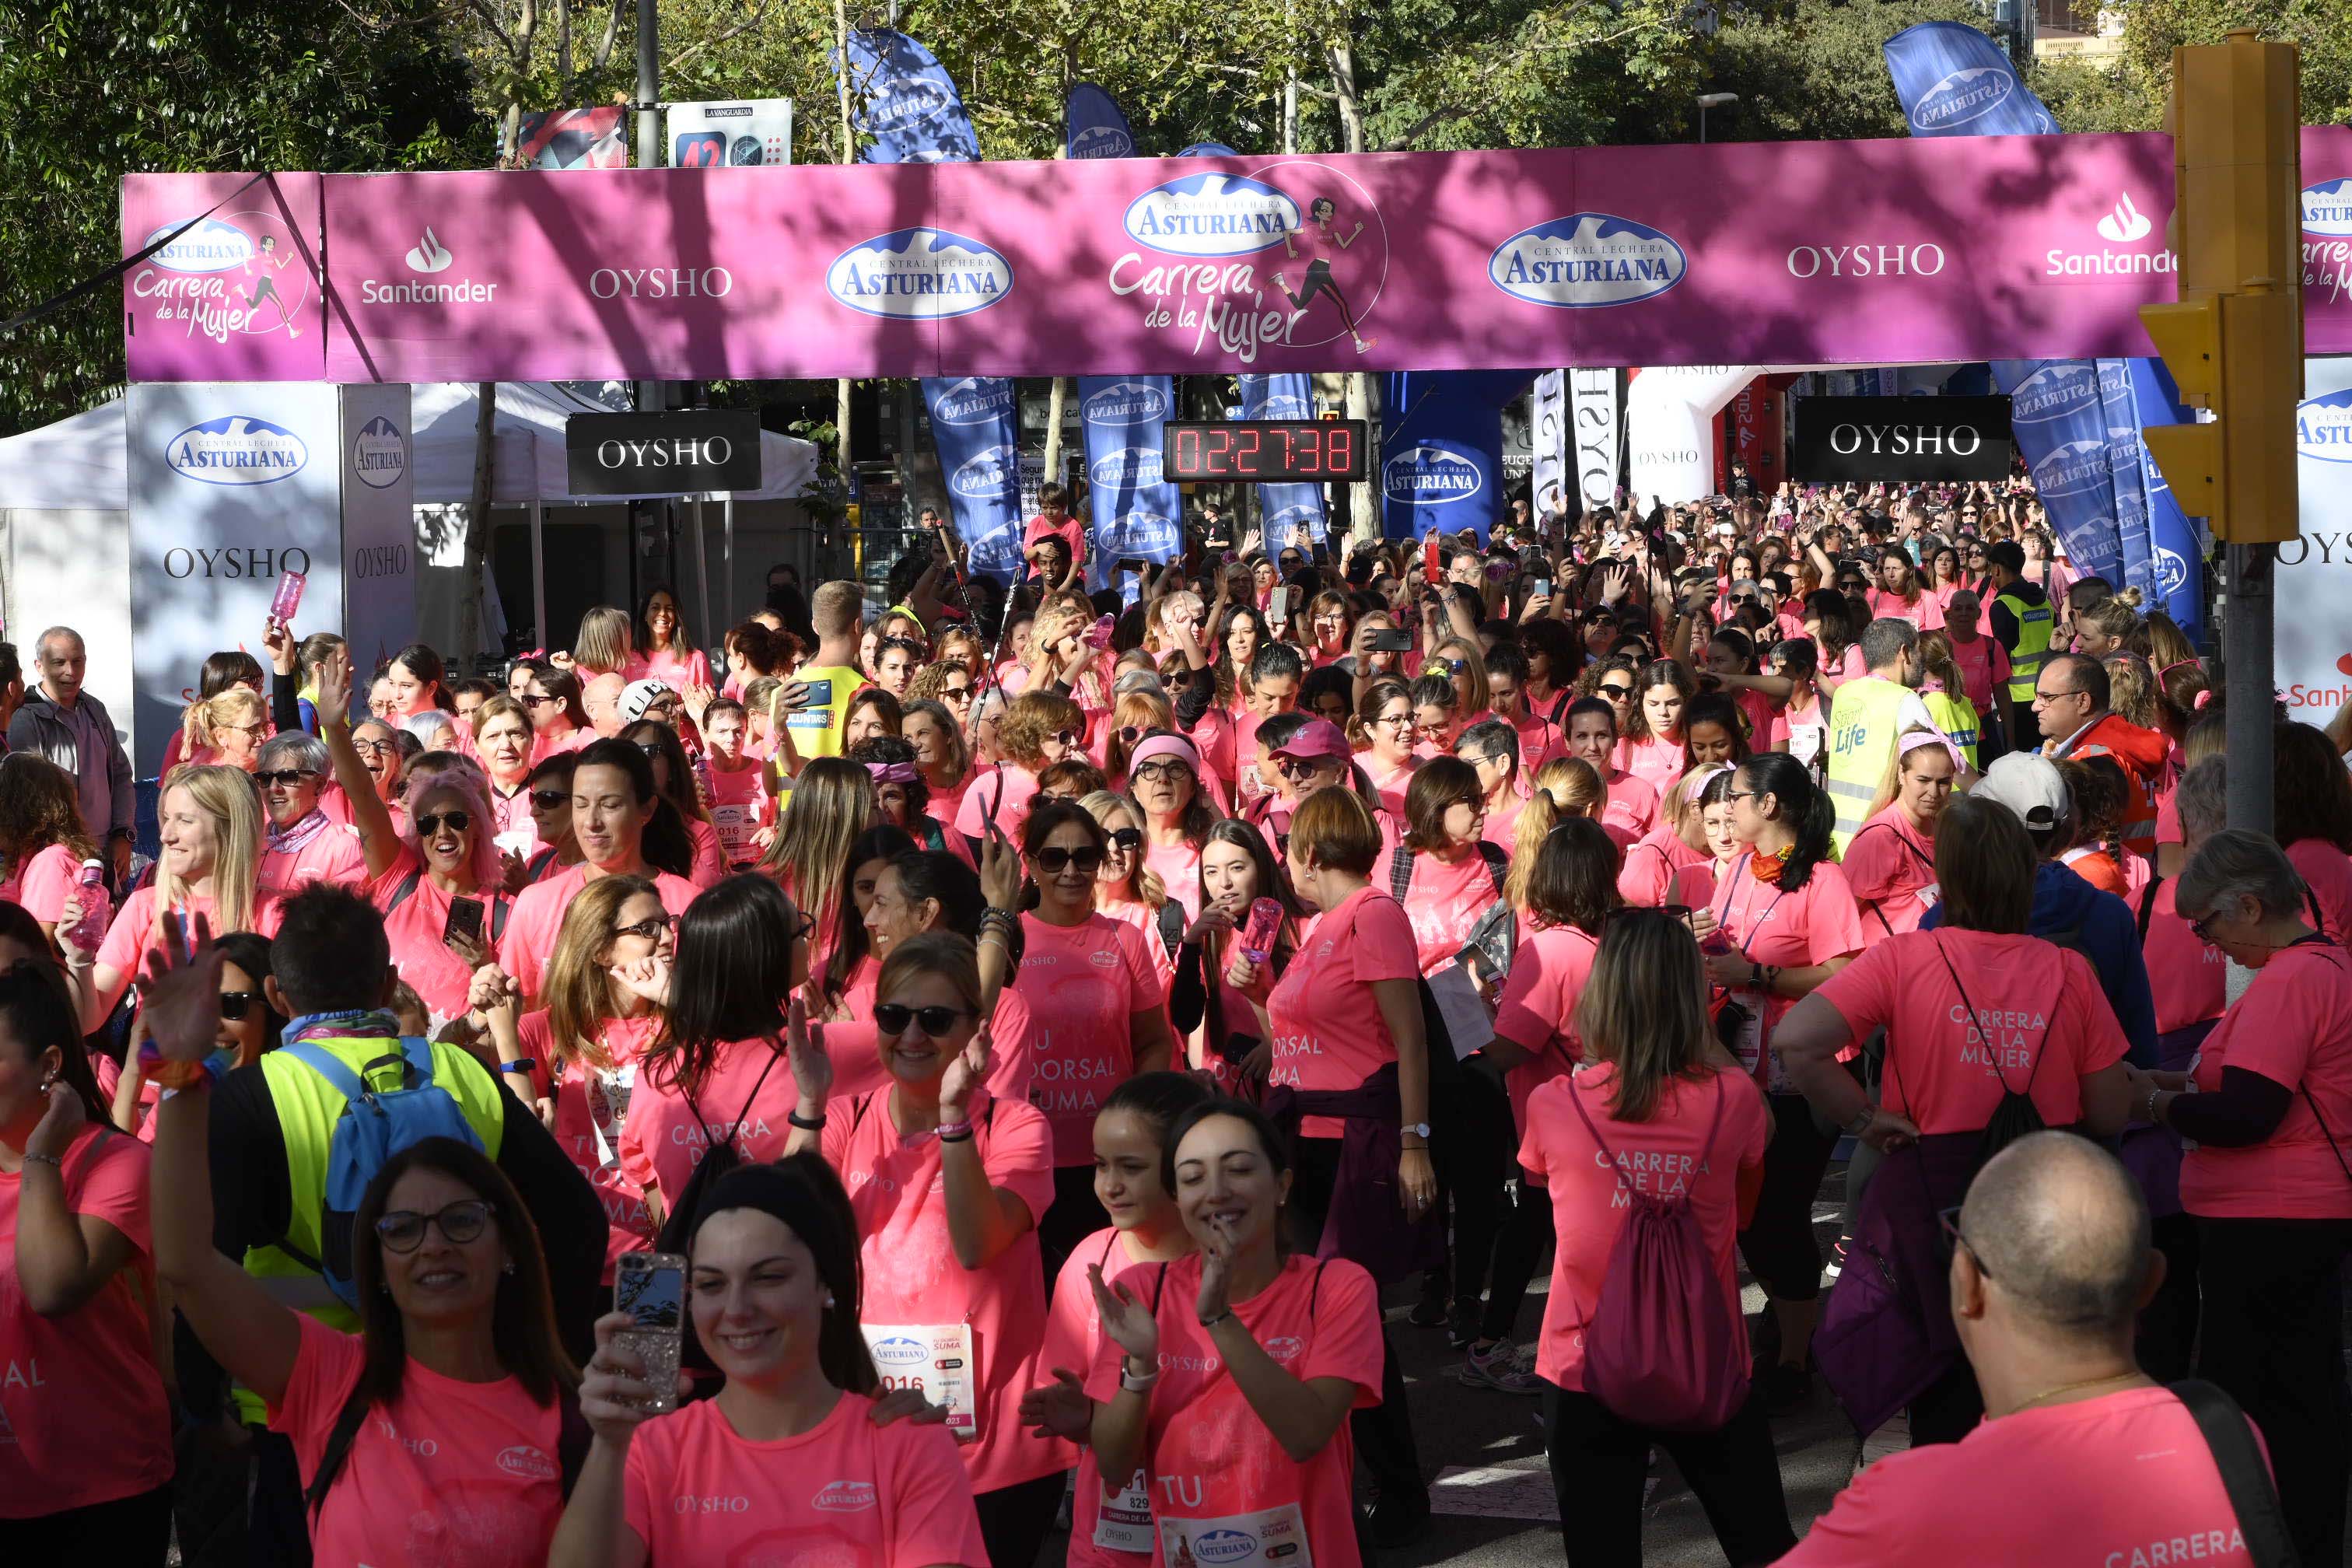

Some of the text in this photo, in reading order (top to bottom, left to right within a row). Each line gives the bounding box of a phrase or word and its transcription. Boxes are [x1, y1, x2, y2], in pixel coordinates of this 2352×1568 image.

[714, 108, 753, 117] VANGUARDIA
[1137, 205, 1287, 235] ASTURIANA
[152, 236, 247, 260] ASTURIANA
[1534, 244, 1664, 256] CENTRAL LECHERA
[1787, 243, 1945, 278] OYSHO
[870, 257, 992, 268] CENTRAL LECHERA
[1108, 252, 1255, 296] Carrera
[1503, 249, 1671, 284] ASTURIANA
[2319, 262, 2333, 285] la
[133, 268, 226, 298] Carrera
[362, 278, 498, 304] Santander
[590, 268, 733, 300] OYSHO
[841, 262, 1000, 296] ASTURIANA
[156, 295, 260, 345] de la Mujer
[1144, 290, 1309, 363] de la Mujer
[1664, 366, 1729, 376] OYSHO
[597, 436, 733, 468] OYSHO
[1177, 430, 1350, 473] 02:27:38
[1829, 422, 1981, 457] OYSHO
[177, 441, 298, 468] ASTURIANA
[357, 446, 402, 471] ASTURIANA
[1639, 449, 1699, 465] OYSHO
[1386, 471, 1474, 492] ASTURIANA
[163, 547, 310, 579] OYSHO
[355, 544, 407, 579] OYSHO
[1836, 723, 1867, 756] Life
[718, 827, 740, 835] 016
[1948, 1004, 2048, 1031] CARRERA
[1035, 1029, 1050, 1051] U
[1272, 1033, 1323, 1059] ORSAL
[1966, 1026, 2027, 1048] DE LA
[1959, 1045, 2031, 1069] MUJER
[1033, 1089, 1098, 1112] UMA
[1595, 1149, 1710, 1175] CARRERA
[1617, 1171, 1687, 1194] DE LA
[604, 1197, 648, 1223] MA
[875, 1348, 925, 1359] ASTURIANA
[933, 1342, 961, 1351] SUMA
[2, 1357, 47, 1388] AL
[1157, 1352, 1219, 1372] OYSHO
[882, 1375, 925, 1394] 016
[1157, 1475, 1203, 1507] TU
[674, 1495, 749, 1514] OYSHO
[1105, 1528, 1132, 1542] OYSHO
[1262, 1526, 1292, 1539] SUMA
[1197, 1540, 1252, 1556] ASTURIANA
